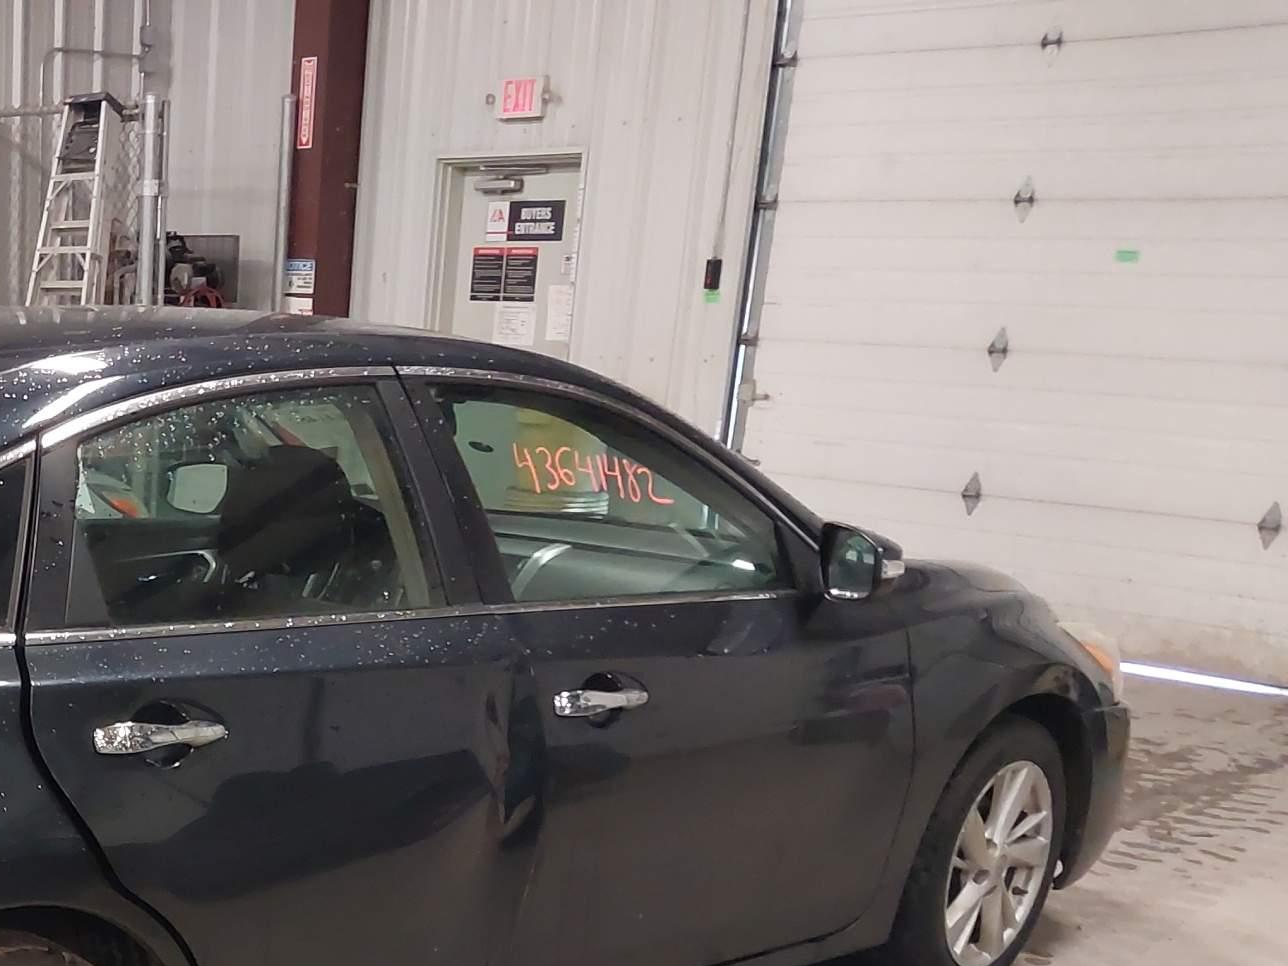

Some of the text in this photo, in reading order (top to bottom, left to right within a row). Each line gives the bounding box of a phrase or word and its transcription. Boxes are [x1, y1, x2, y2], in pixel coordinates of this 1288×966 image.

[503, 79, 536, 113] EXIT
[521, 207, 552, 220] BUYERS
[515, 221, 556, 235] ENTRANCE
[512, 443, 675, 504] 43641482
